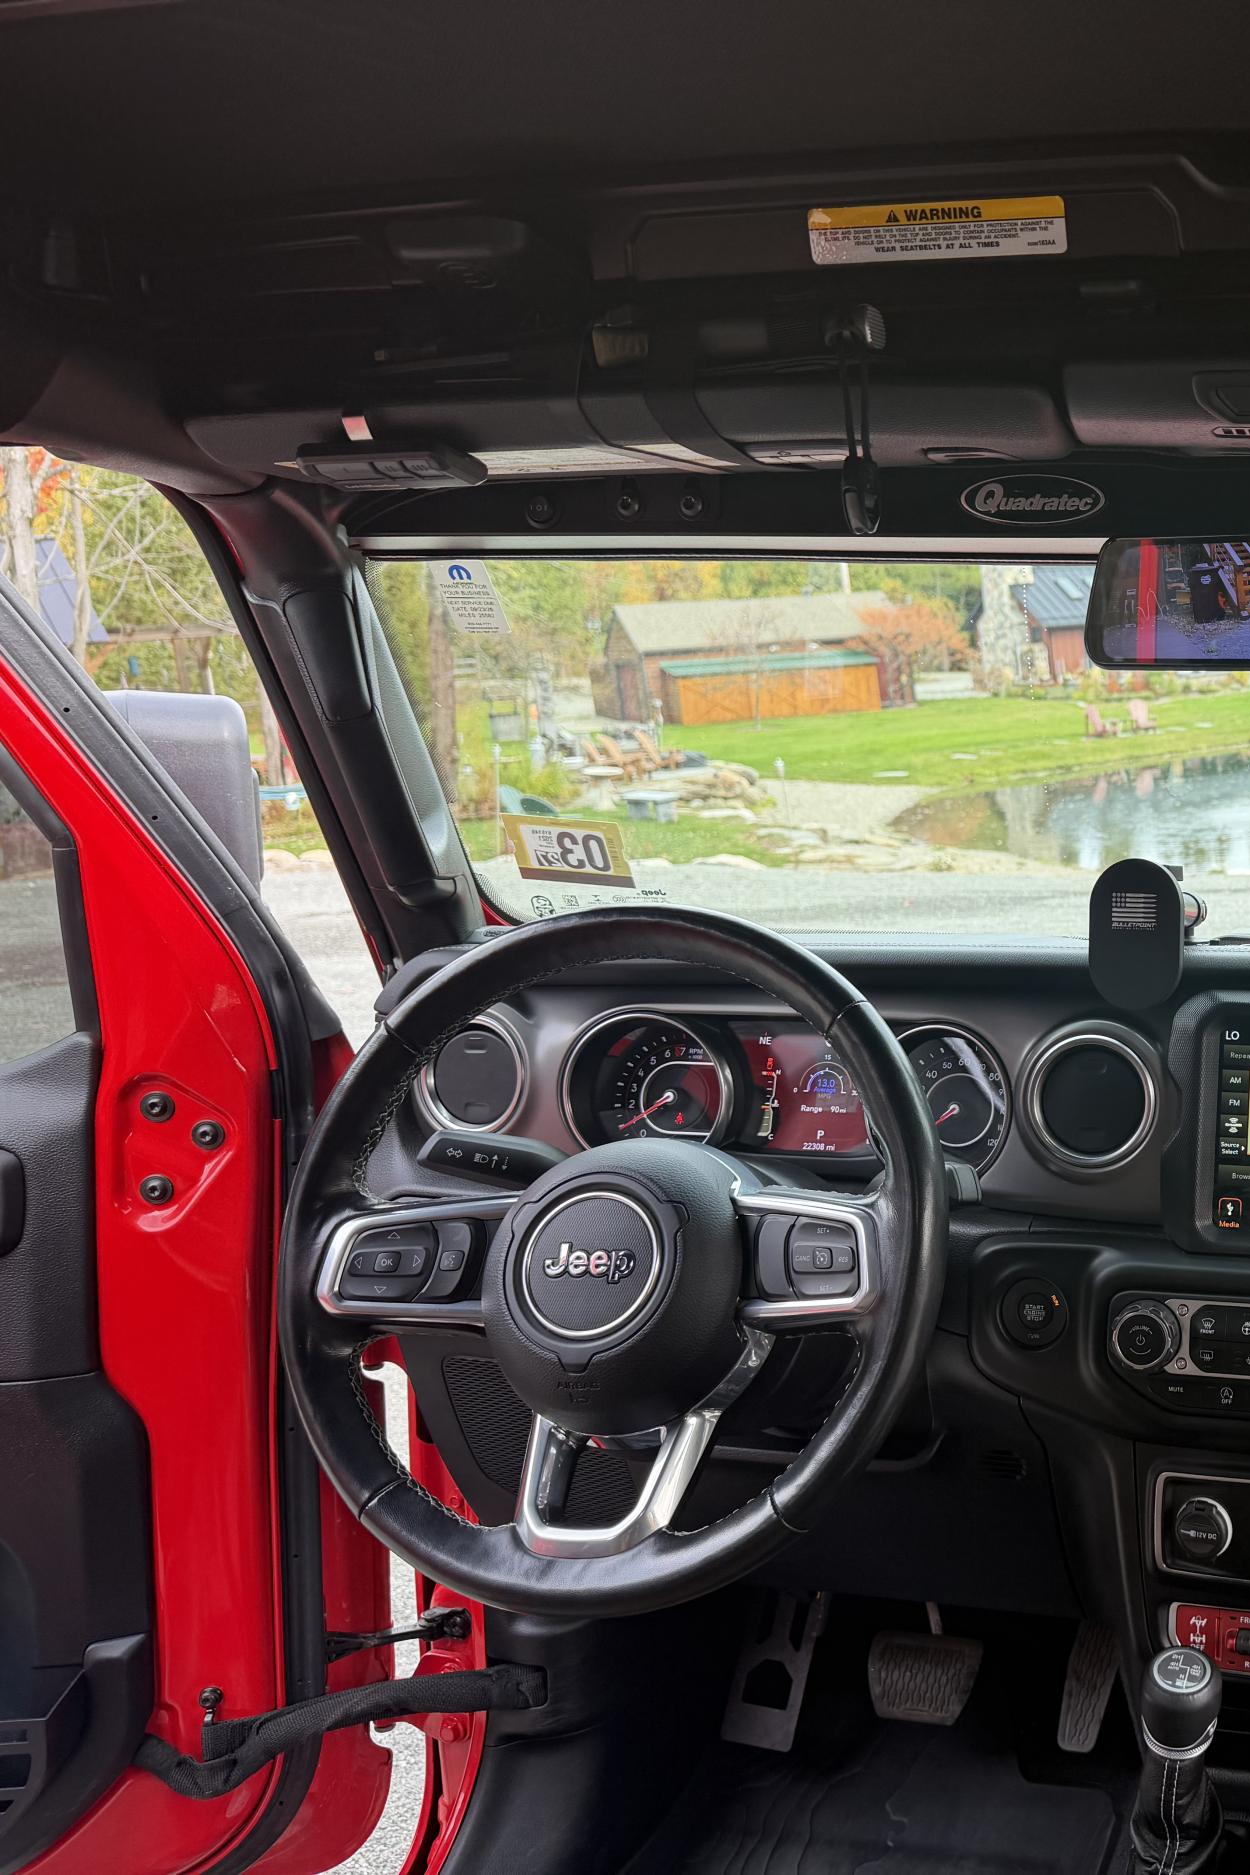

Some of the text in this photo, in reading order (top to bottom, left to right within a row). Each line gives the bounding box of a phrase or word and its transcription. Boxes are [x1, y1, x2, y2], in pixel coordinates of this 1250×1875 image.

[904, 206, 982, 222] WARNING
[900, 244, 942, 252] SEATBELTS
[975, 483, 1094, 513] Quadratec
[1225, 1030, 1240, 1041] LO
[759, 1037, 773, 1045] NE
[665, 1049, 671, 1057] 6
[650, 1056, 656, 1065] 5
[958, 1058, 971, 1066] 60
[638, 1068, 644, 1077] 4
[926, 1071, 938, 1079] 40
[988, 1073, 1000, 1081] 80
[1229, 1076, 1242, 1084] AM
[817, 1079, 835, 1088] 13.0
[631, 1084, 637, 1092] 3
[628, 1100, 635, 1108] 2
[1229, 1099, 1241, 1107] FM
[801, 1104, 823, 1114] Range
[640, 1129, 646, 1137] 0
[817, 1130, 825, 1139] P
[802, 1142, 824, 1151] 22308
[1219, 1220, 1240, 1228] Media
[381, 1258, 393, 1266] OK
[544, 1242, 636, 1284] Jeep
[1196, 1531, 1207, 1539] 12V
